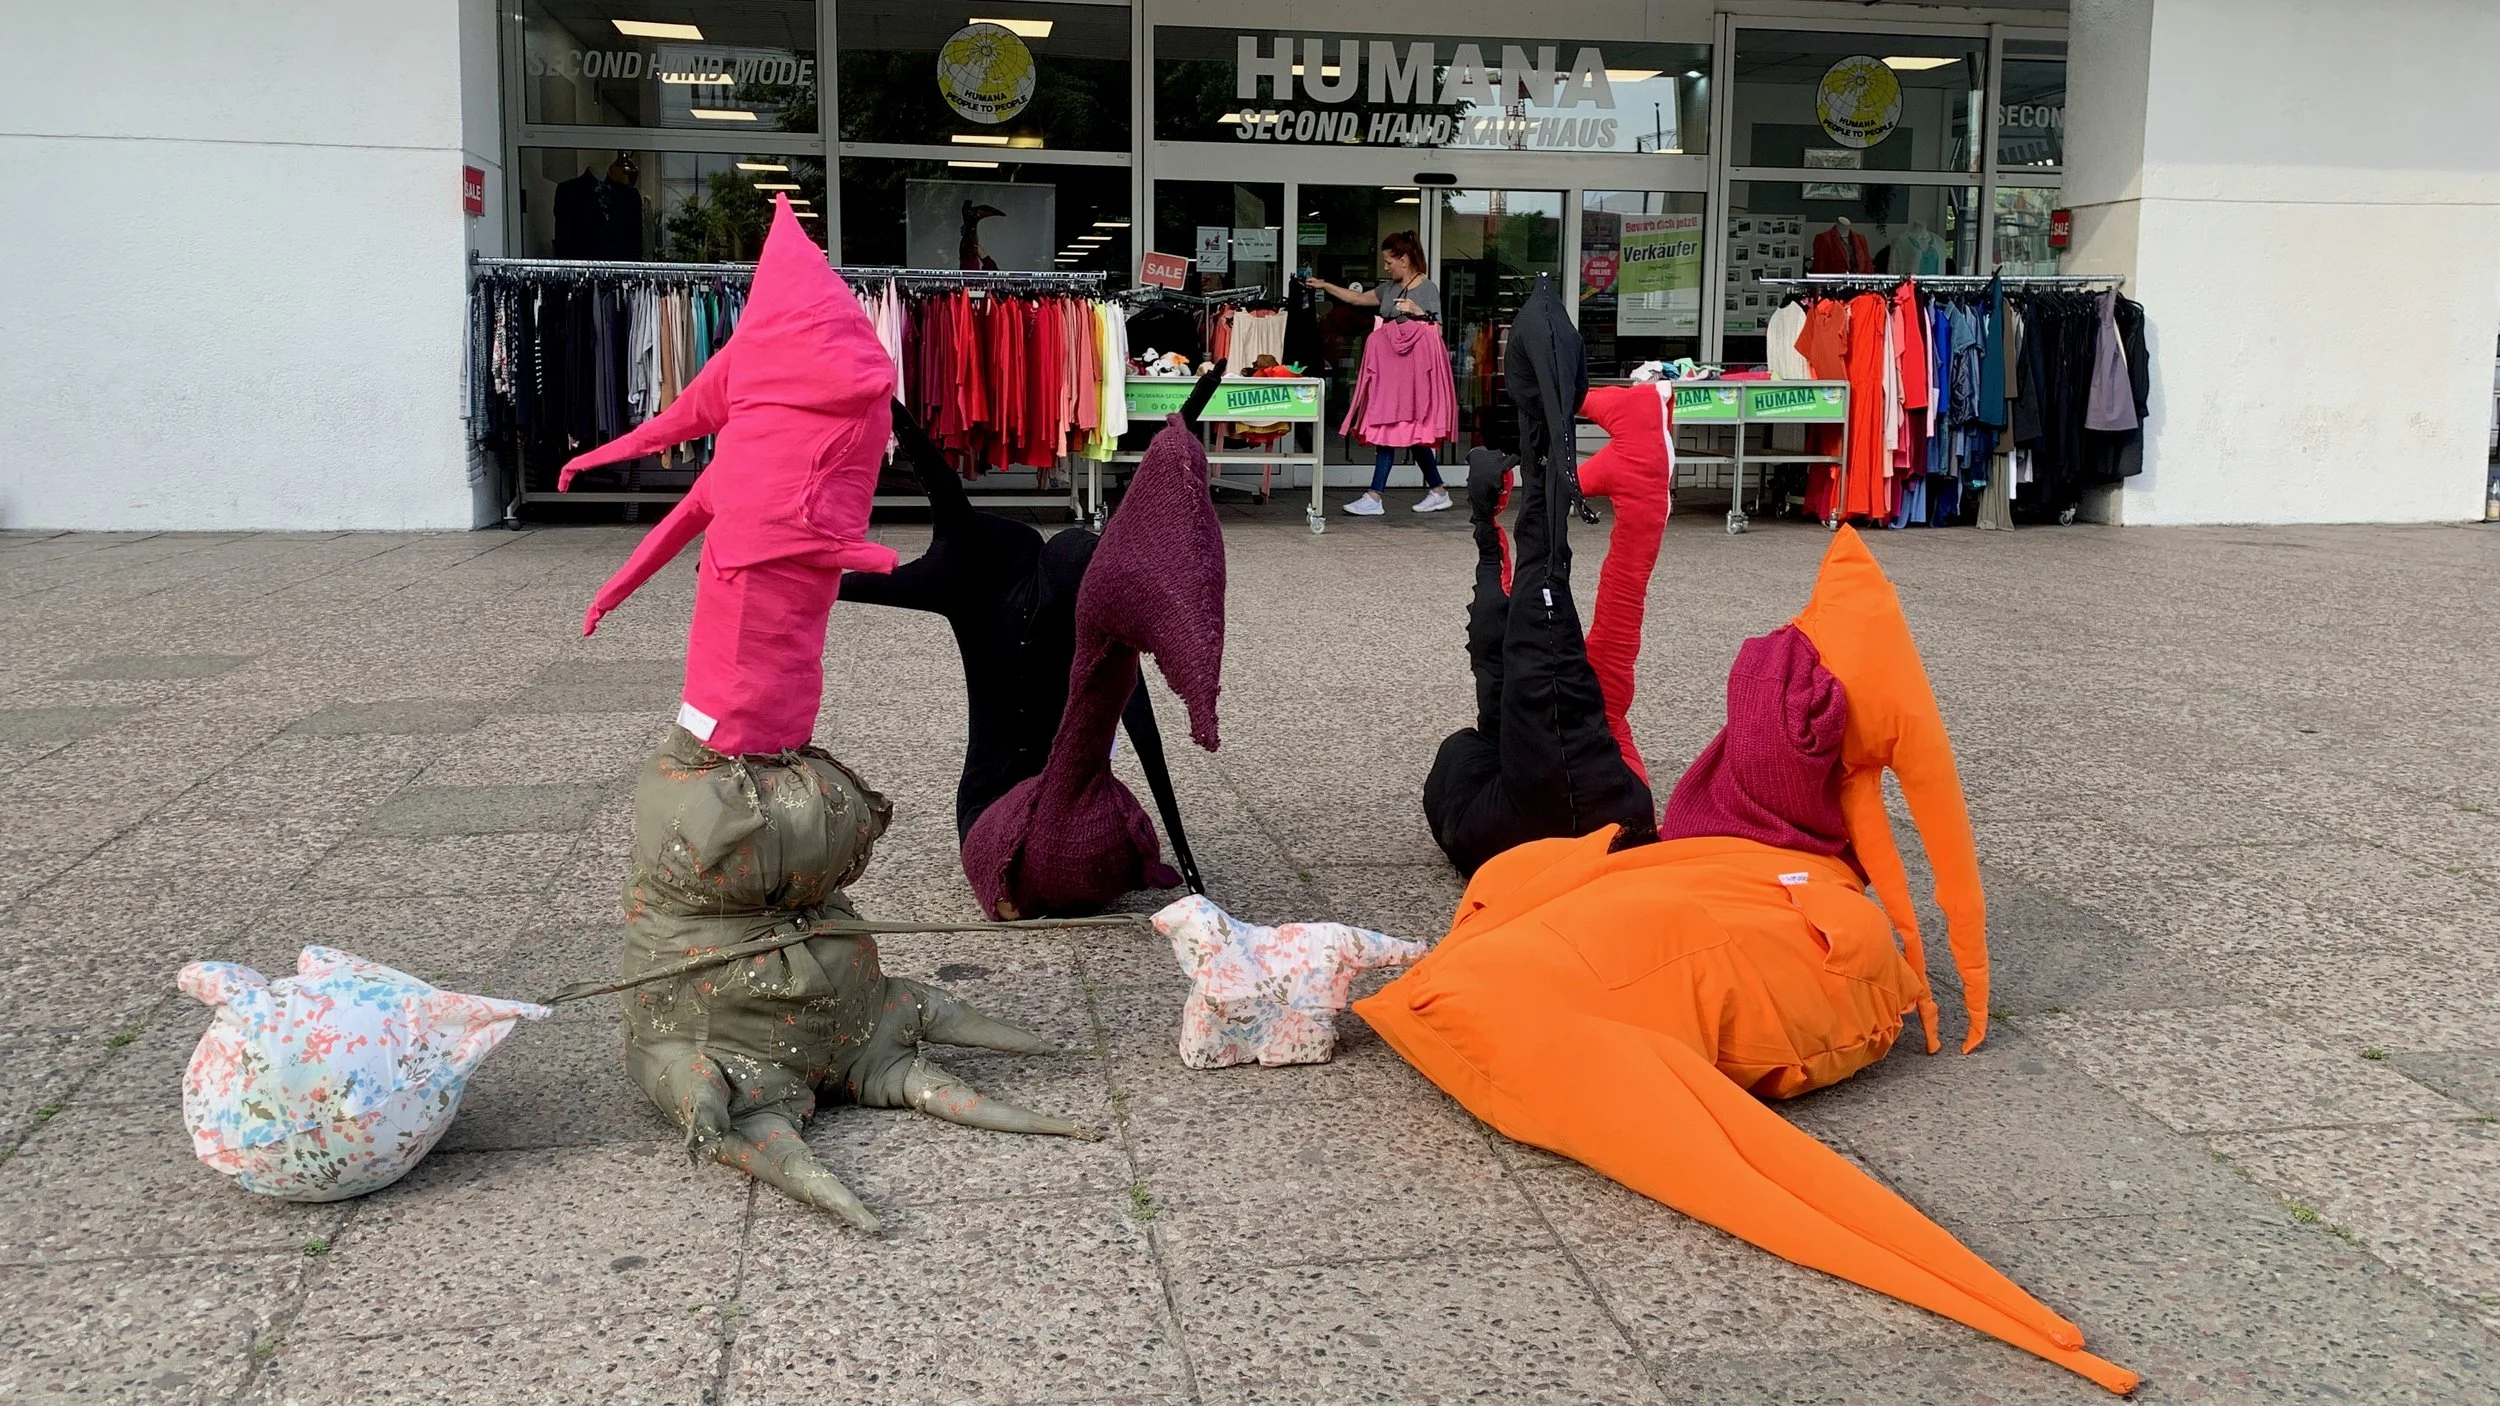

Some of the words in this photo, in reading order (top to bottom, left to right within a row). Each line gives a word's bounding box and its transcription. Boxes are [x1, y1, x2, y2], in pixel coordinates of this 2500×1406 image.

[528, 49, 643, 80] SECOND
[646, 52, 723, 82] HAND
[732, 57, 815, 86] MODE
[1236, 35, 1616, 109] HUMANA
[945, 91, 980, 111] PEOPLE
[981, 104, 993, 113] TO
[995, 94, 1028, 112] PEOPLE
[964, 90, 1007, 102] HUMANA
[1839, 116, 1876, 128] HUMANA
[1998, 105, 2065, 128] SECON
[1236, 108, 1359, 142] SECOND
[1368, 112, 1452, 146] HAND
[1460, 115, 1619, 149] KAUFHAUS
[1822, 118, 1851, 137] PEOPLE
[1865, 120, 1894, 137] PEOPLE
[464, 181, 481, 201] SALE
[2054, 222, 2069, 236] SALE
[1622, 239, 1698, 263] Verkäufer
[1146, 263, 1183, 279] SALE
[1227, 387, 1291, 408] HUMANA
[1674, 388, 1712, 406] MANA
[1754, 388, 1817, 409] HUMANA
